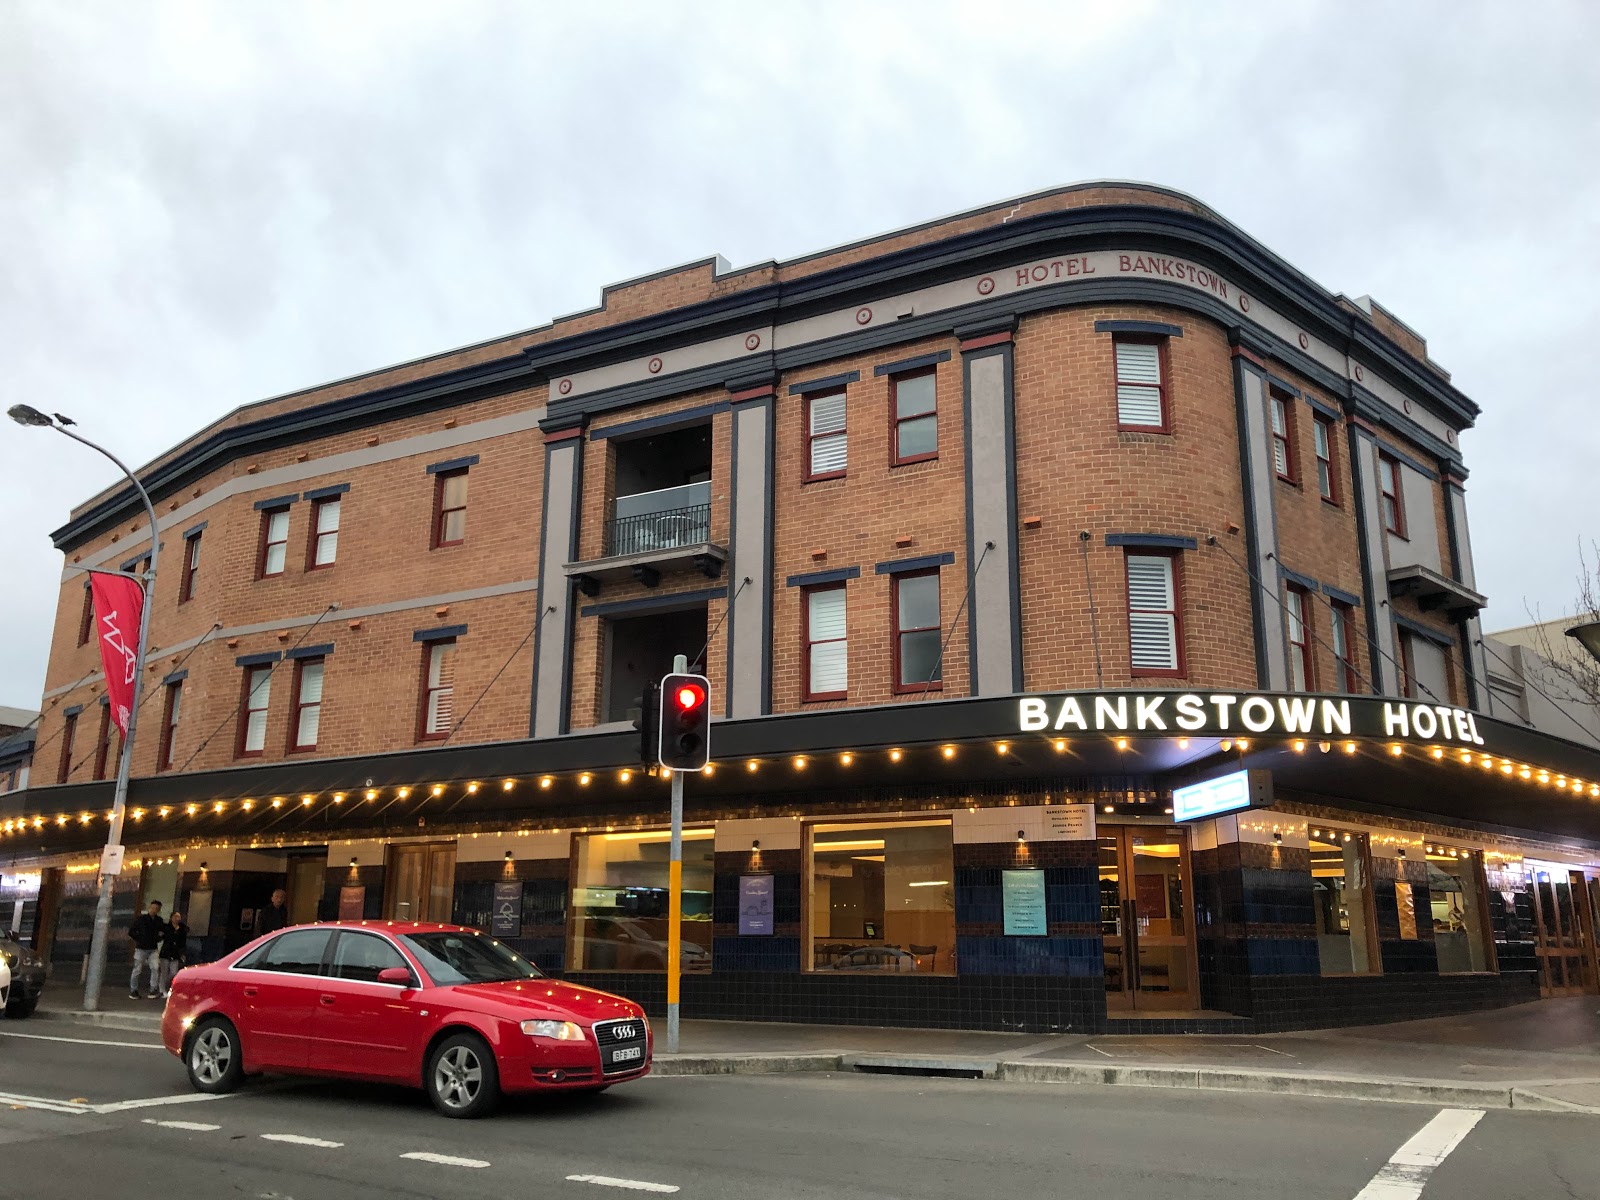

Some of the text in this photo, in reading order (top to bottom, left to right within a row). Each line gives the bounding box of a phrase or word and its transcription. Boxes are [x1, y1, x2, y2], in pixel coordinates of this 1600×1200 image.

[1016, 255, 1228, 299] HOTEL BANKSTOWN
[1019, 694, 1484, 745] BANKSTOWN HOTEL
